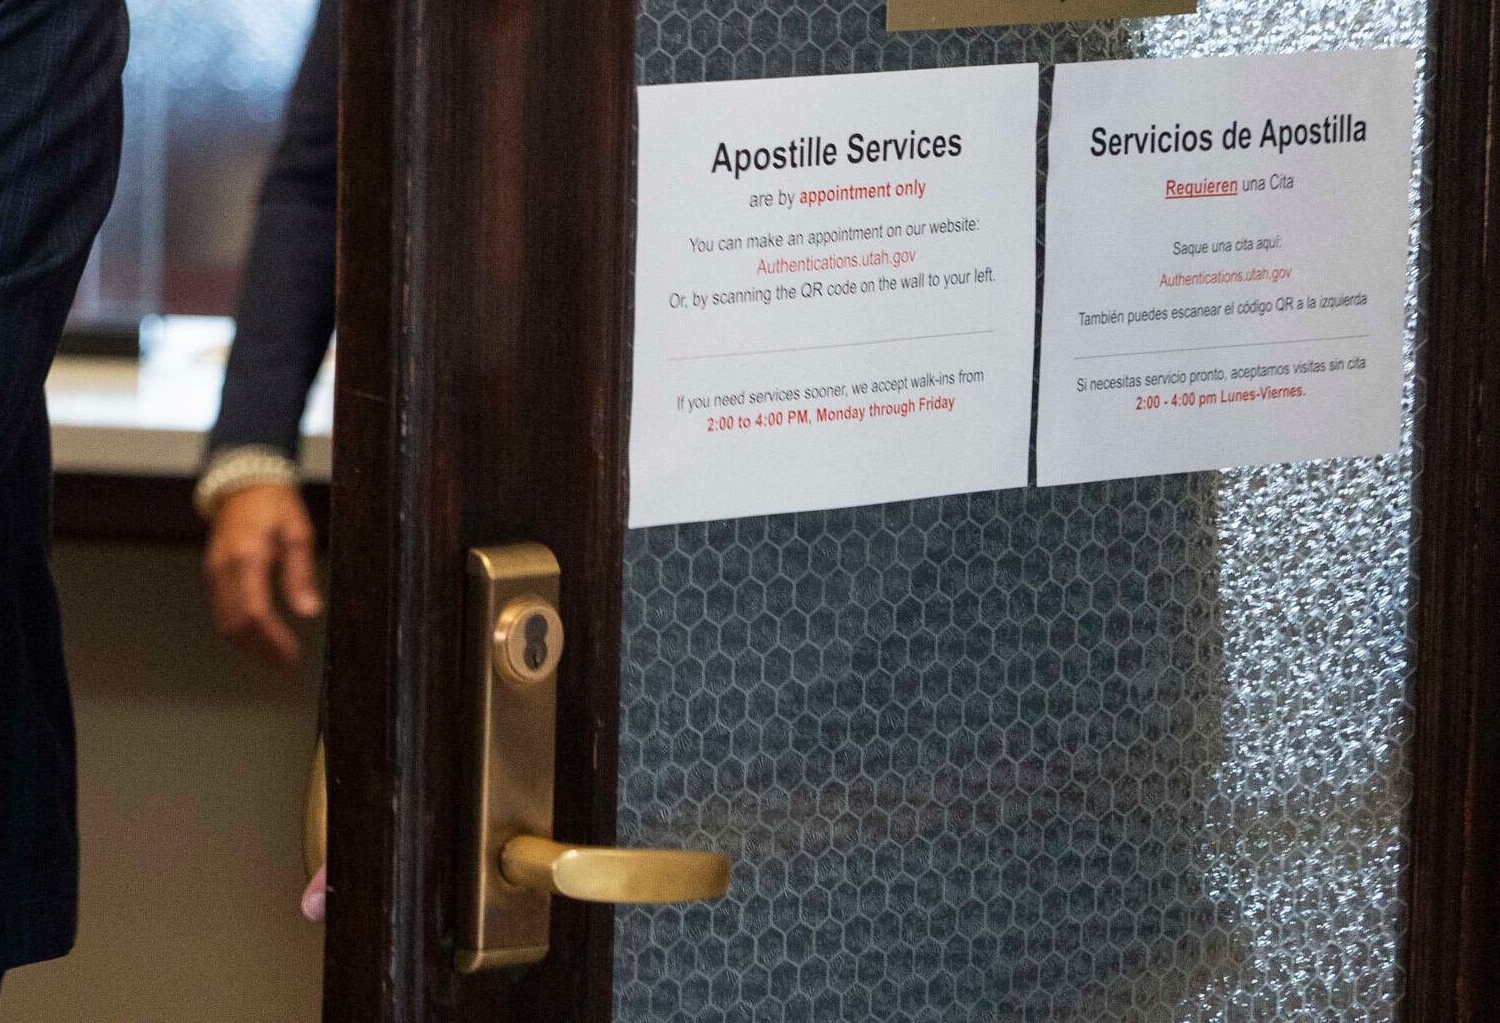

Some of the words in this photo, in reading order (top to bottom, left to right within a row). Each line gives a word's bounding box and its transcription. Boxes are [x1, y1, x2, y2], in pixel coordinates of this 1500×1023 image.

[1090, 123, 1213, 157] Servicios
[1222, 121, 1251, 149] de
[1260, 114, 1367, 153] Apostilla
[712, 136, 838, 179] Apostille
[847, 130, 962, 164] Services
[749, 192, 774, 209] are
[778, 190, 795, 209] by
[799, 182, 891, 207] appointment
[896, 180, 926, 199] only
[1165, 179, 1238, 199] Requieren
[1242, 176, 1265, 192] una
[1269, 174, 1294, 190] Cita
[689, 237, 714, 253] You
[718, 237, 743, 251] can
[747, 233, 784, 249] make
[788, 235, 804, 246] an
[808, 225, 883, 247] appointment
[887, 226, 901, 238] on
[905, 223, 926, 237] our
[929, 218, 980, 235] website:
[1173, 240, 1208, 257] Saque
[1212, 241, 1232, 253] una
[1235, 238, 1253, 251] cita
[757, 249, 916, 275] Authentications.utah.gov
[1159, 267, 1292, 287] Authentications.utah.gov
[693, 291, 708, 309] by
[712, 287, 771, 306] scanning
[776, 284, 796, 300] the
[801, 282, 823, 299] QR
[827, 280, 857, 296] code
[861, 280, 875, 293] on
[879, 276, 897, 292] the
[901, 273, 924, 289] wall
[928, 273, 940, 287] to
[944, 270, 971, 287] your
[1128, 306, 1168, 325] puedes
[1171, 304, 1222, 319] escanear
[1225, 302, 1234, 315] el
[1276, 297, 1294, 312] QR
[1297, 299, 1303, 309] a
[1307, 296, 1316, 308] la
[1319, 292, 1368, 309] izquierda
[677, 395, 685, 411] If
[688, 396, 710, 412] you
[714, 392, 745, 408] need
[749, 387, 801, 405] services
[852, 383, 869, 395] we
[872, 376, 908, 394] accept
[911, 371, 955, 389] walk-ins
[959, 369, 985, 385] from
[1076, 378, 1087, 392] Si
[1090, 376, 1142, 391] necesitas
[1145, 371, 1187, 386] servicio
[1231, 366, 1290, 382] aceptamos
[1293, 361, 1326, 374] visitas
[1329, 359, 1345, 372] sin
[1348, 357, 1366, 370] cita
[707, 416, 734, 432] 2:00
[738, 415, 751, 430] to
[755, 412, 783, 427] 4:00
[816, 405, 865, 422] Monday
[869, 399, 915, 418] through
[919, 395, 955, 414] Friday
[1136, 395, 1160, 410] 2:00
[1171, 392, 1196, 406] 4:00
[1199, 392, 1217, 408] pm
